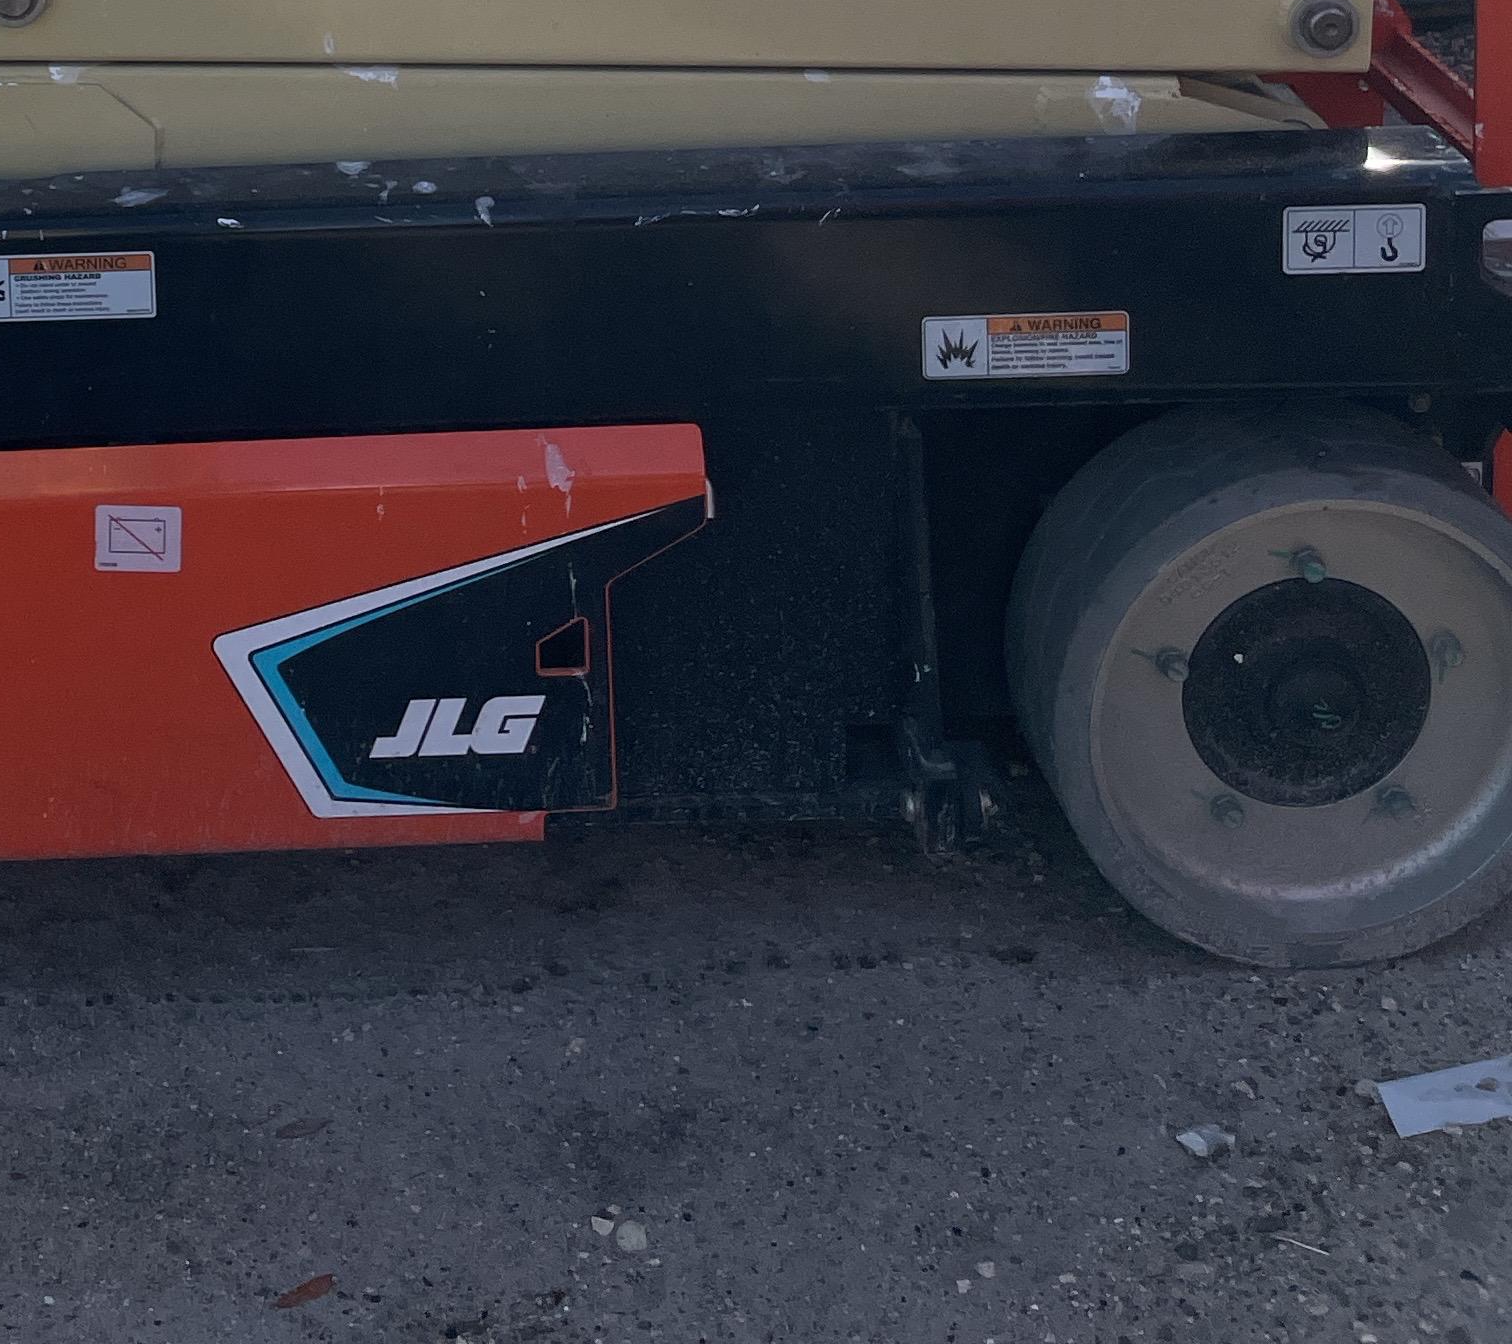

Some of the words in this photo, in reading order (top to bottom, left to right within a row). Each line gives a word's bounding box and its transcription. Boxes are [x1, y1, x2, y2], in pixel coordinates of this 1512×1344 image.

[49, 257, 127, 271] WARNING
[1028, 317, 1102, 331] WARNING
[368, 694, 547, 759] JLG
